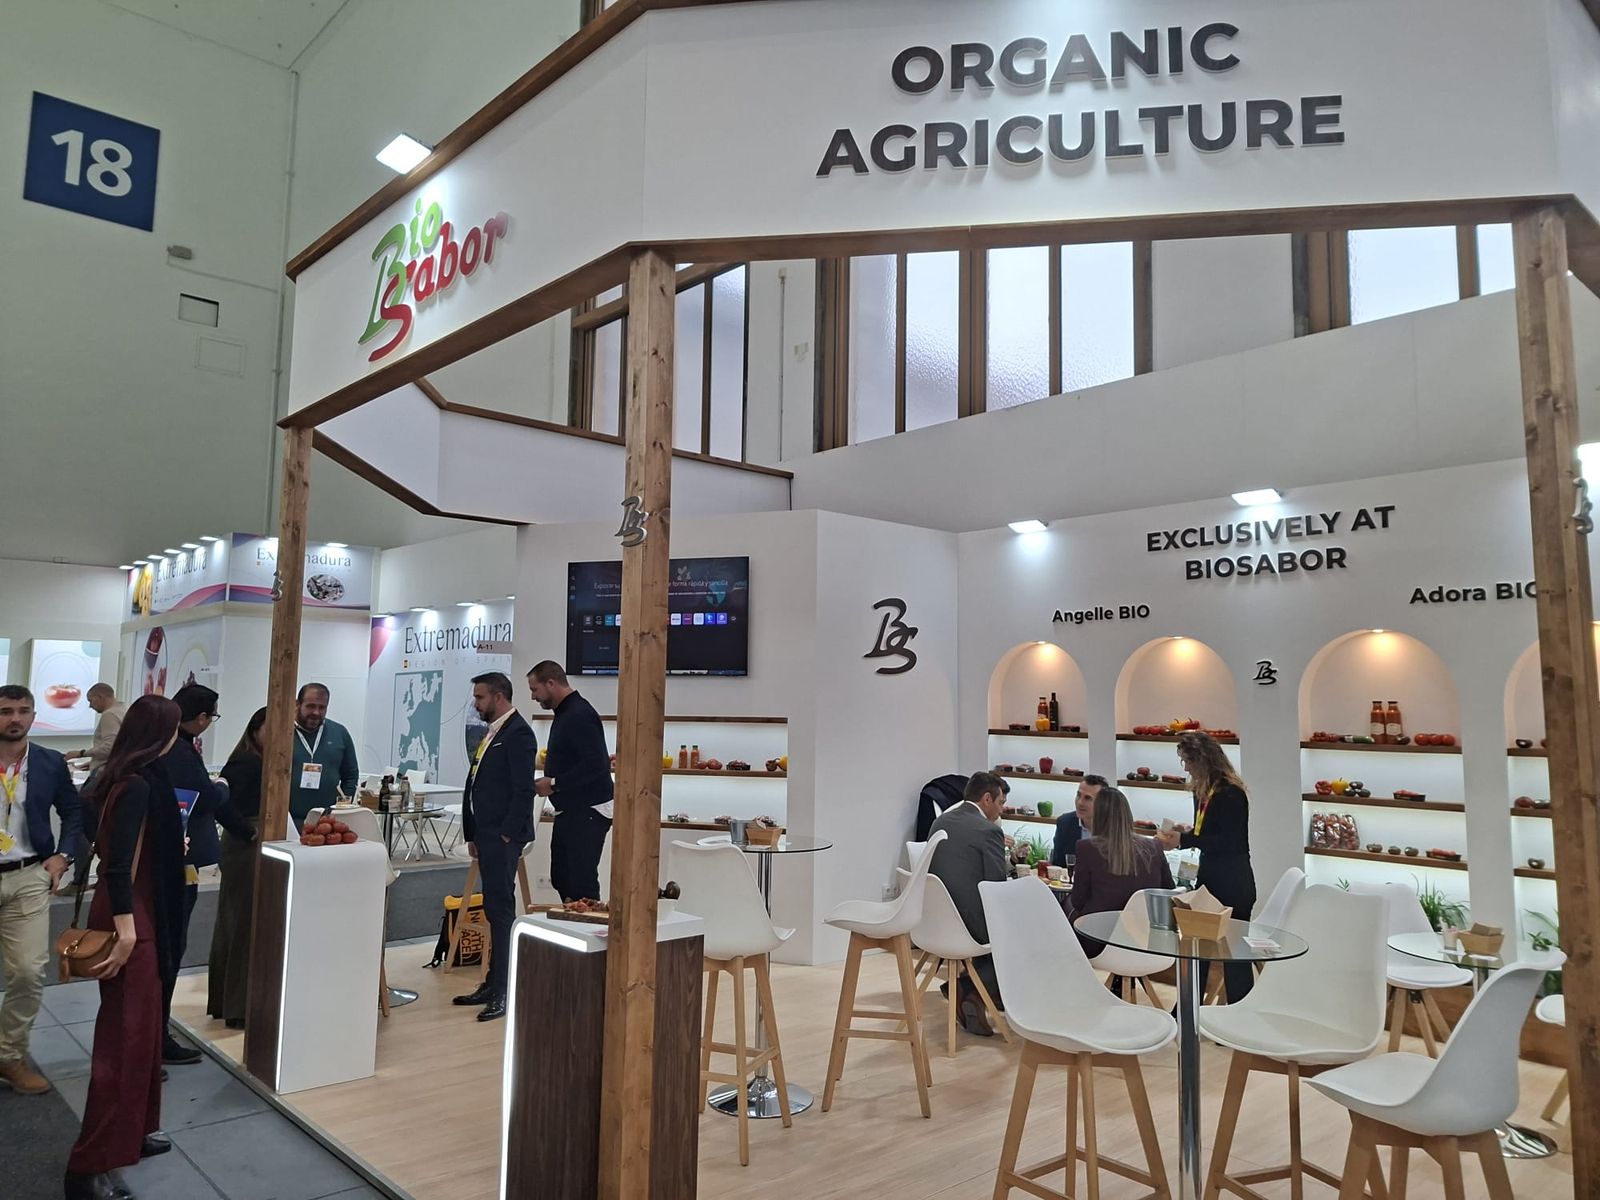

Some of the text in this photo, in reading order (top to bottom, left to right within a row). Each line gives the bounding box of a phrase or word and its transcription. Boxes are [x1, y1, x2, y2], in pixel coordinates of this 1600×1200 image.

[891, 23, 1240, 94] ORGANIC
[816, 94, 1345, 178] AGRICULTURE
[51, 129, 134, 198] 18
[358, 198, 443, 346] Bio
[368, 211, 509, 363] Sabor
[1147, 504, 1396, 551] EXCLUSIVELY AT
[1185, 547, 1348, 581] BIOSABOR
[1052, 604, 1150, 627] Angelle BIO
[1410, 585, 1488, 606] Adora
[405, 618, 512, 654] Extremadura
[477, 643, 494, 651] A-11
